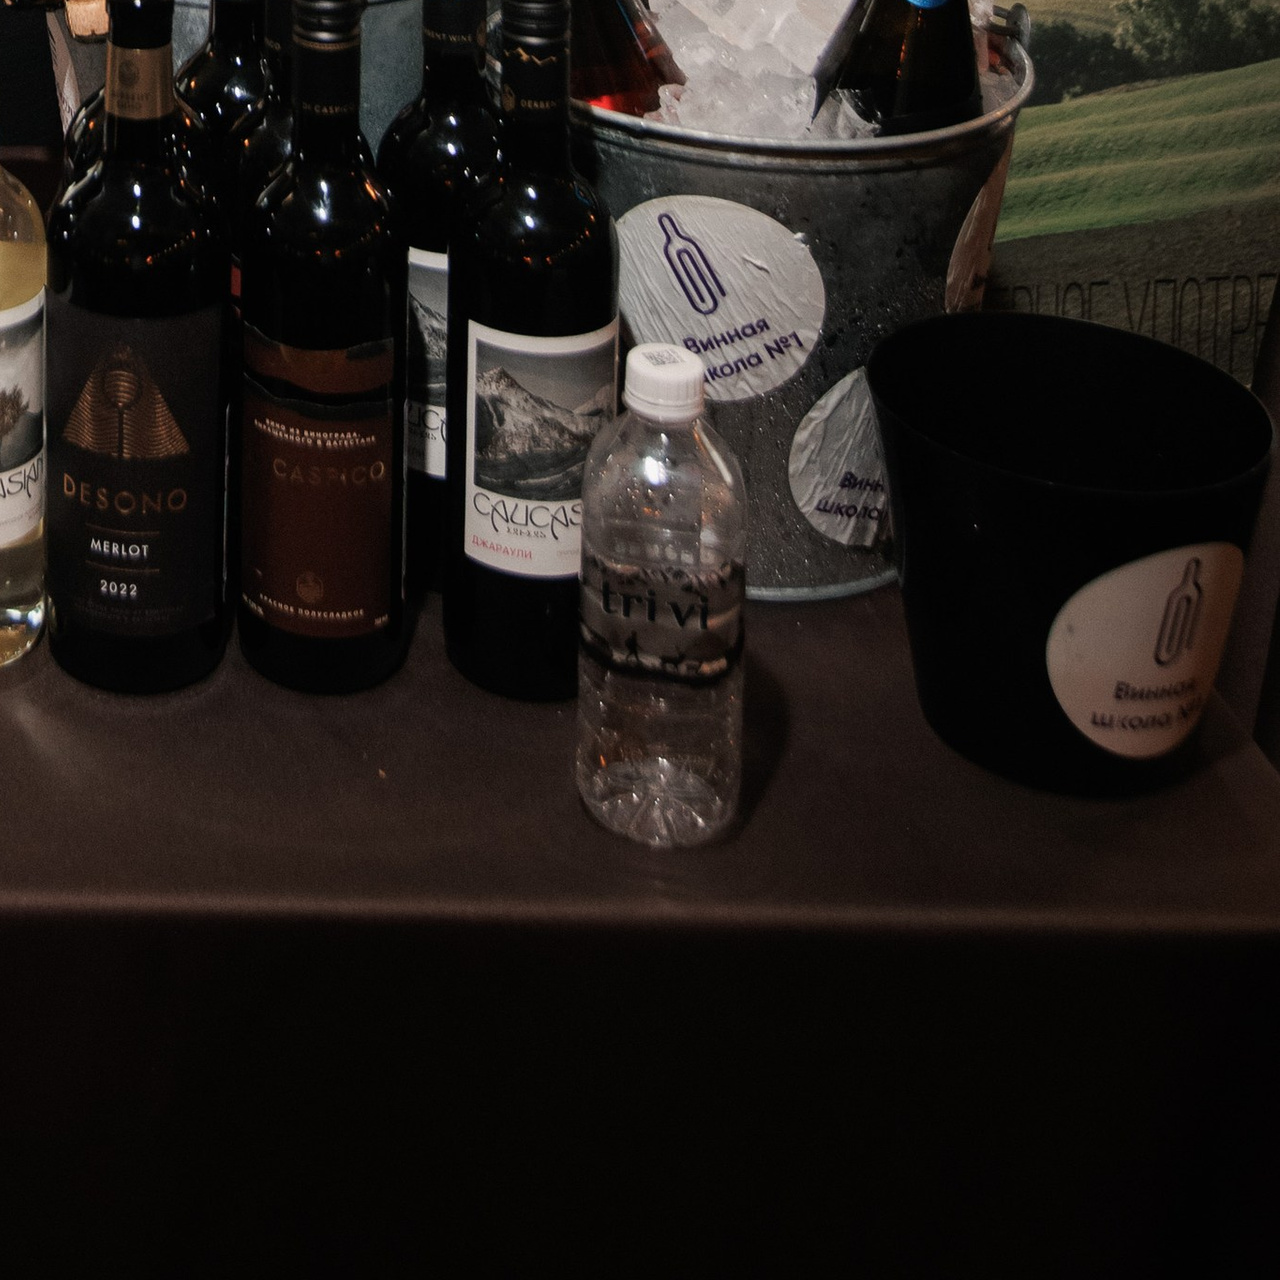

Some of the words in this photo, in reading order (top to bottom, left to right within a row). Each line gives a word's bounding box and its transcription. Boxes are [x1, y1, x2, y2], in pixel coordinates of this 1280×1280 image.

[683, 317, 770, 355] Винная
[704, 352, 763, 383] кола
[763, 330, 804, 359] №1
[63, 471, 188, 515] DESONO
[90, 537, 150, 559] MERLOT
[471, 534, 533, 561] ДЖАРАУЛИ
[99, 578, 139, 597] 2022
[602, 580, 656, 621] tri
[667, 593, 709, 630] vi
